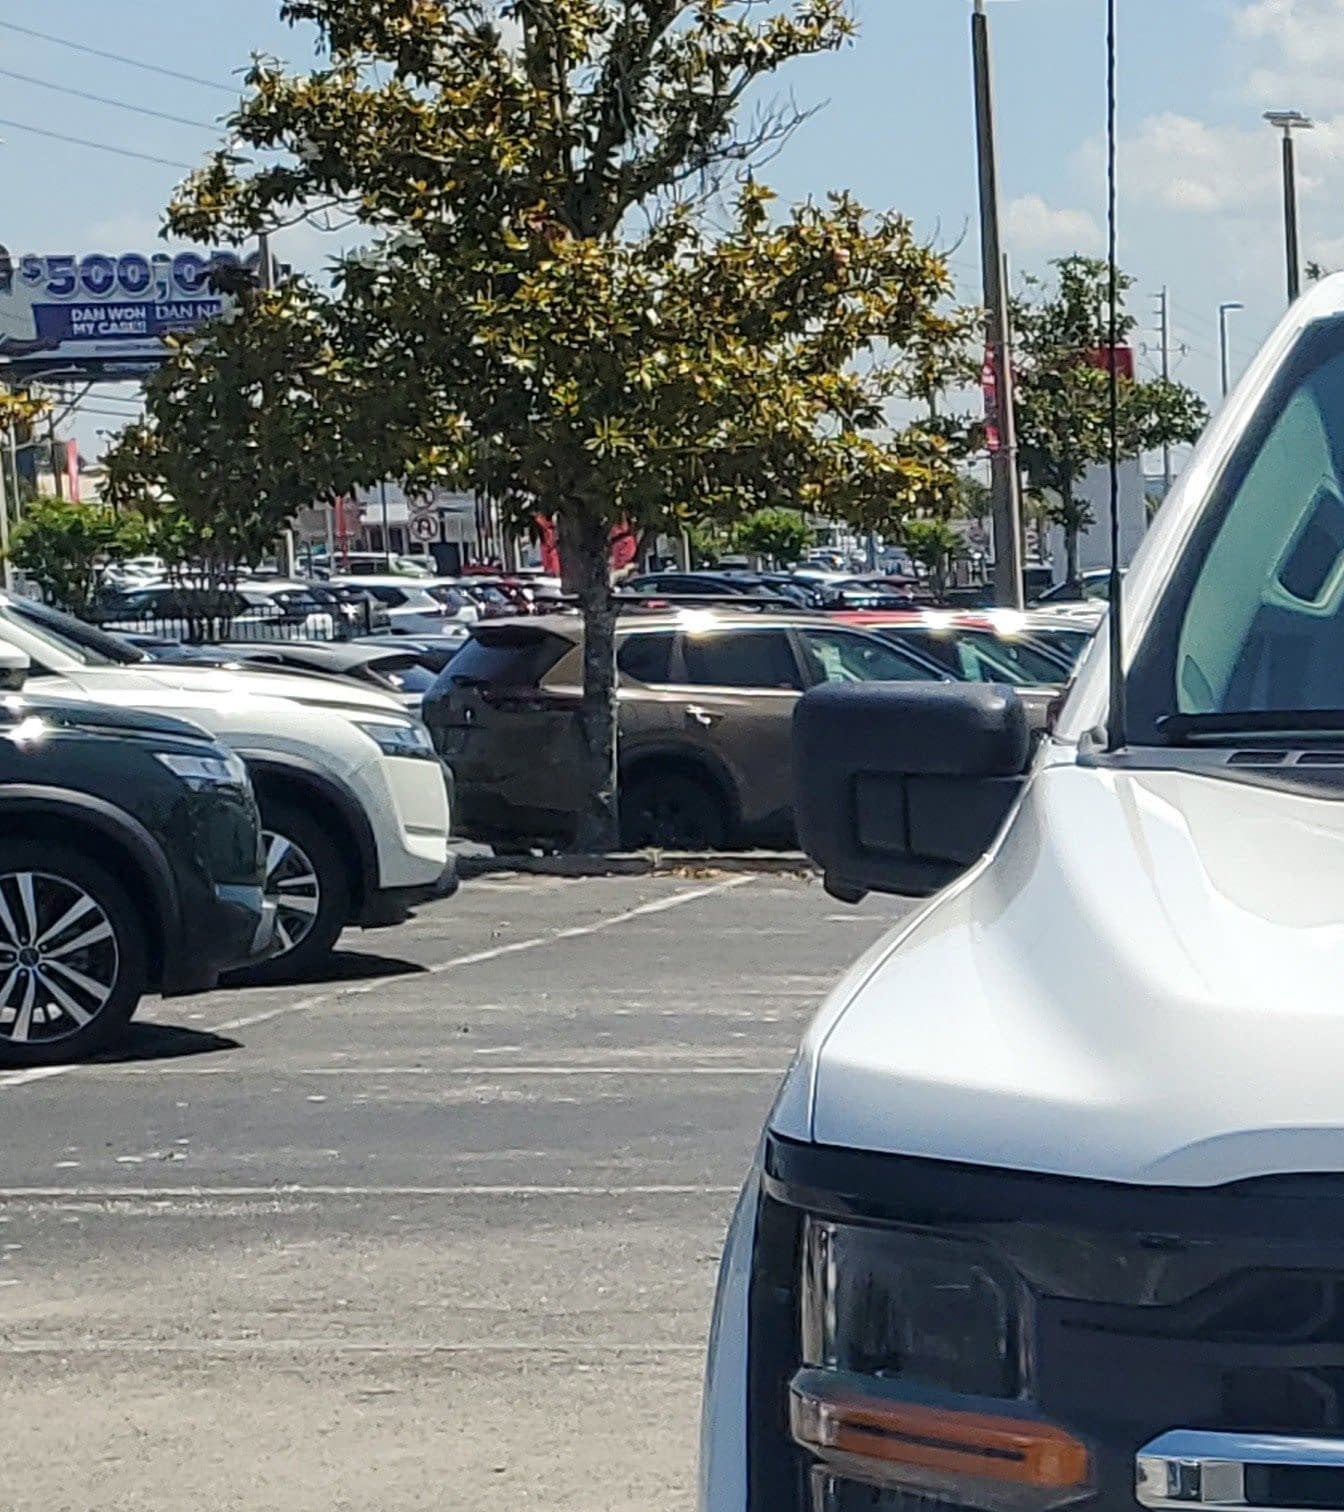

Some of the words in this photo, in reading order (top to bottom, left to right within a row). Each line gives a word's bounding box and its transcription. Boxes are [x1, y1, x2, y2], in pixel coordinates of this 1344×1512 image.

[71, 306, 106, 322] DAN
[108, 305, 147, 321] WON
[155, 303, 194, 320] DAN
